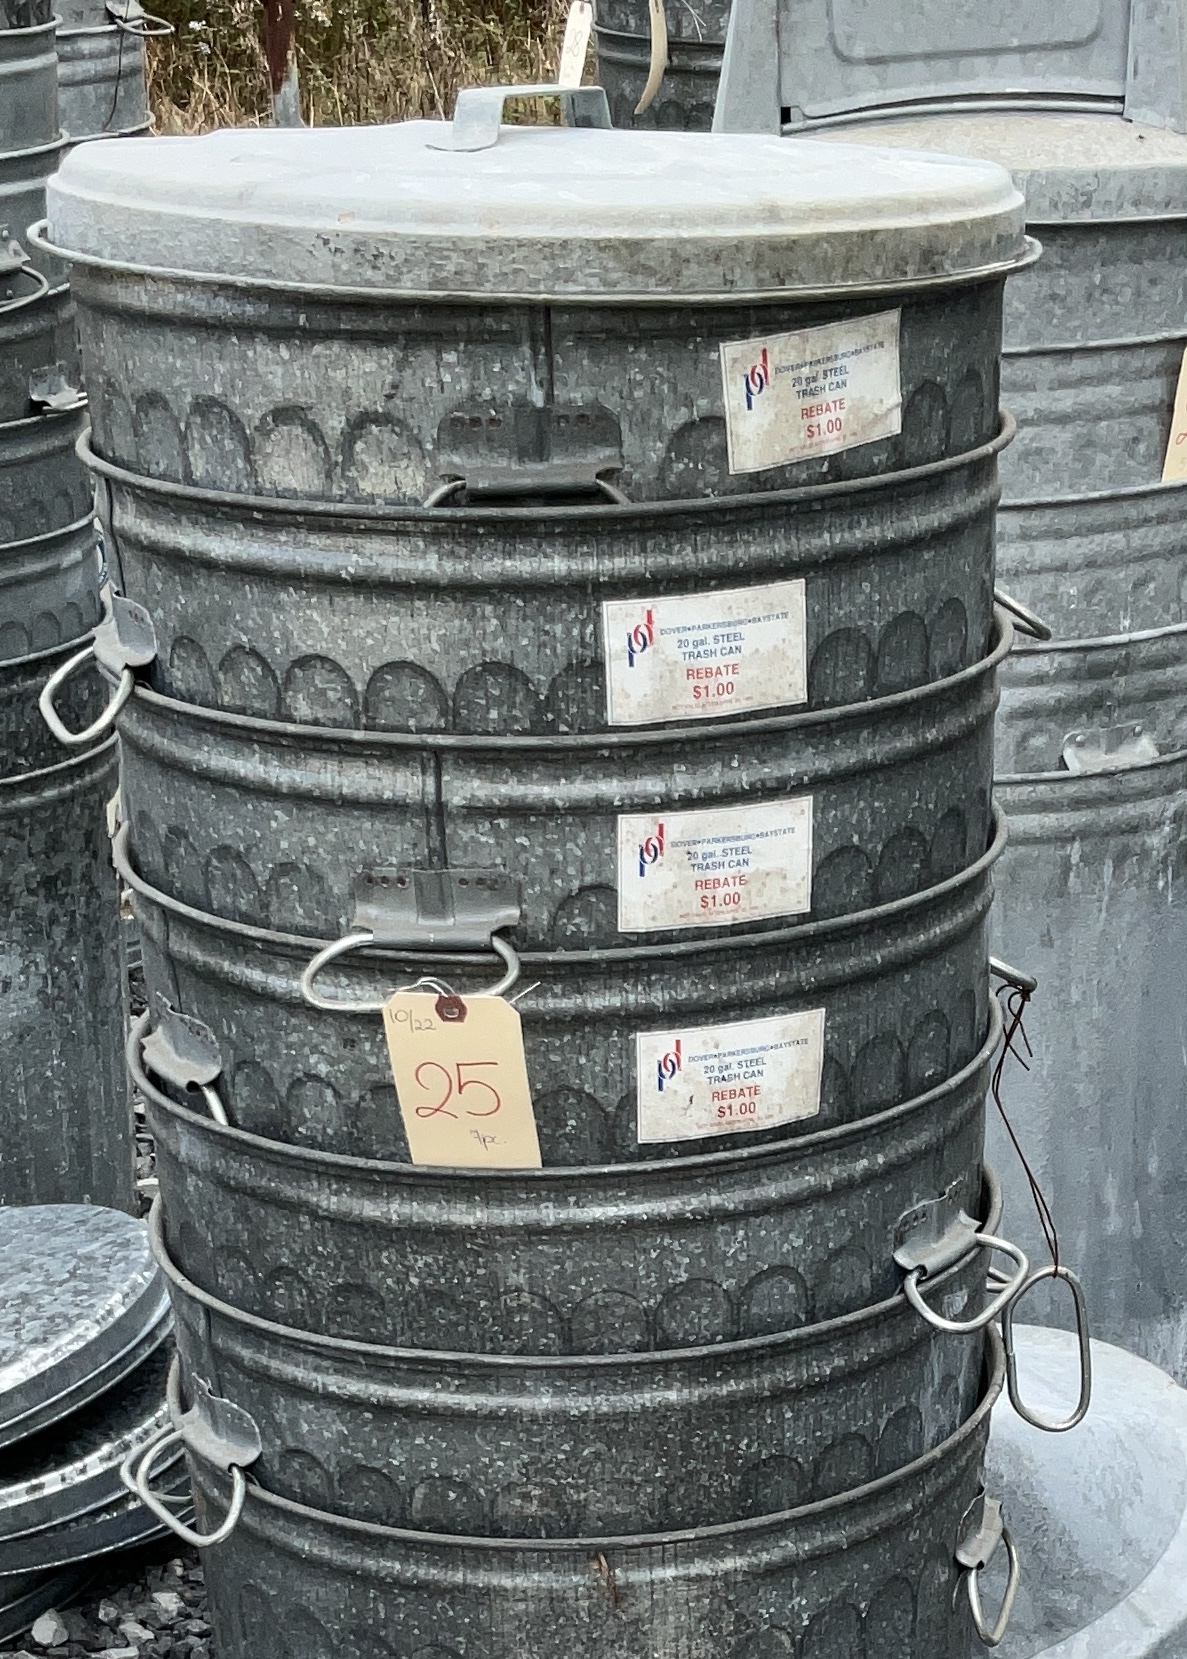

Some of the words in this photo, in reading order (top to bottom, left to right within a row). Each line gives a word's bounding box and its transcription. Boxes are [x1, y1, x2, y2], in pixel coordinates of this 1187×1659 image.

[791, 376, 803, 388] 20
[822, 365, 849, 380] STEEL
[796, 384, 827, 399] TRASH
[828, 379, 847, 392] CAN
[800, 398, 846, 420] REBATE
[806, 418, 842, 438] $1.00
[677, 638, 690, 649] 20
[713, 632, 745, 644] STEEL
[682, 649, 718, 661] TRASH
[720, 645, 742, 657] CAN
[686, 663, 739, 680] REBATE
[693, 681, 734, 700] $1.00
[687, 850, 699, 861] 20
[721, 846, 753, 858] STEEL
[690, 861, 726, 872] TRASH
[728, 858, 750, 869] CAN
[694, 875, 748, 891] REBATE
[700, 892, 741, 909] $1.00
[389, 1008, 437, 1032] 10/22
[703, 1064, 715, 1075] 20
[736, 1057, 767, 1069] STEEL
[707, 1073, 741, 1085] TRASH
[743, 1069, 764, 1079] CAN
[415, 1061, 501, 1119] 25
[711, 1085, 762, 1102] REBATE
[717, 1102, 756, 1119] $1.00
